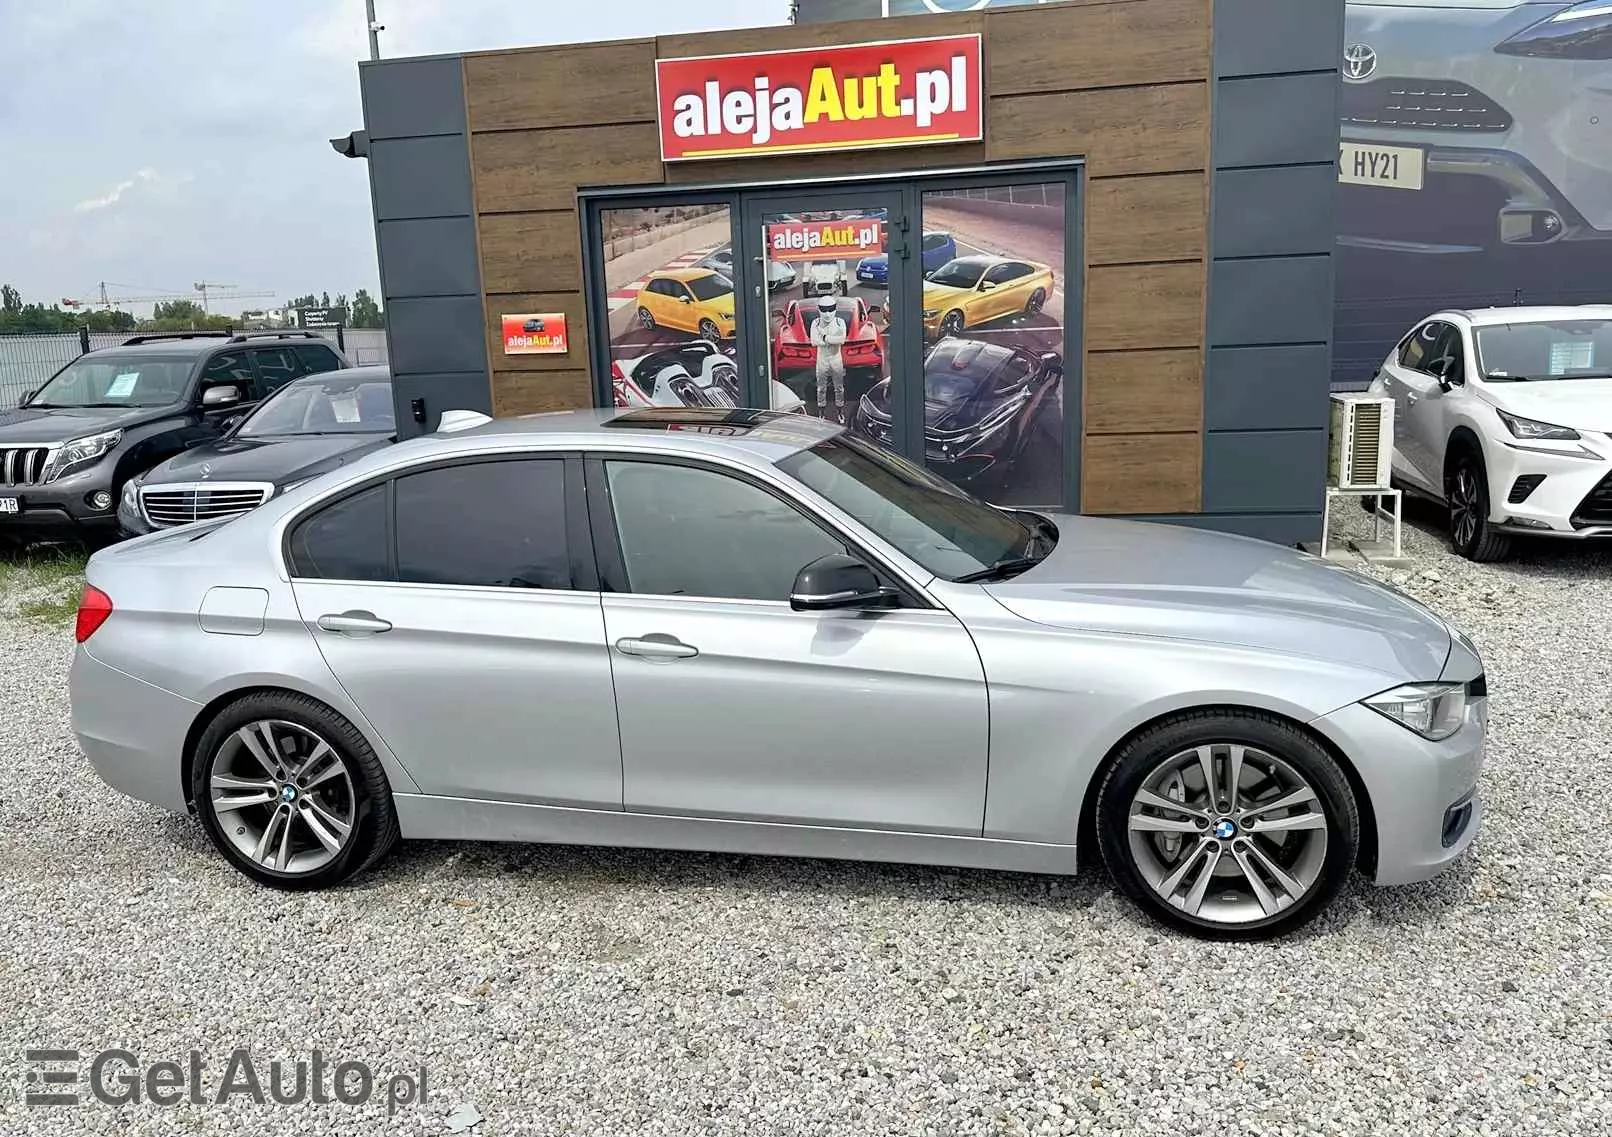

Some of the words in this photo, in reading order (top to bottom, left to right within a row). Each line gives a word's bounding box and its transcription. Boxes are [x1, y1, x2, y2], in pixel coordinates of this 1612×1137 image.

[673, 56, 966, 144] alejaAut.pl
[1353, 150, 1398, 180] HY21
[774, 224, 878, 252] alejaAut.pl
[508, 335, 563, 348] alejaAut.pl
